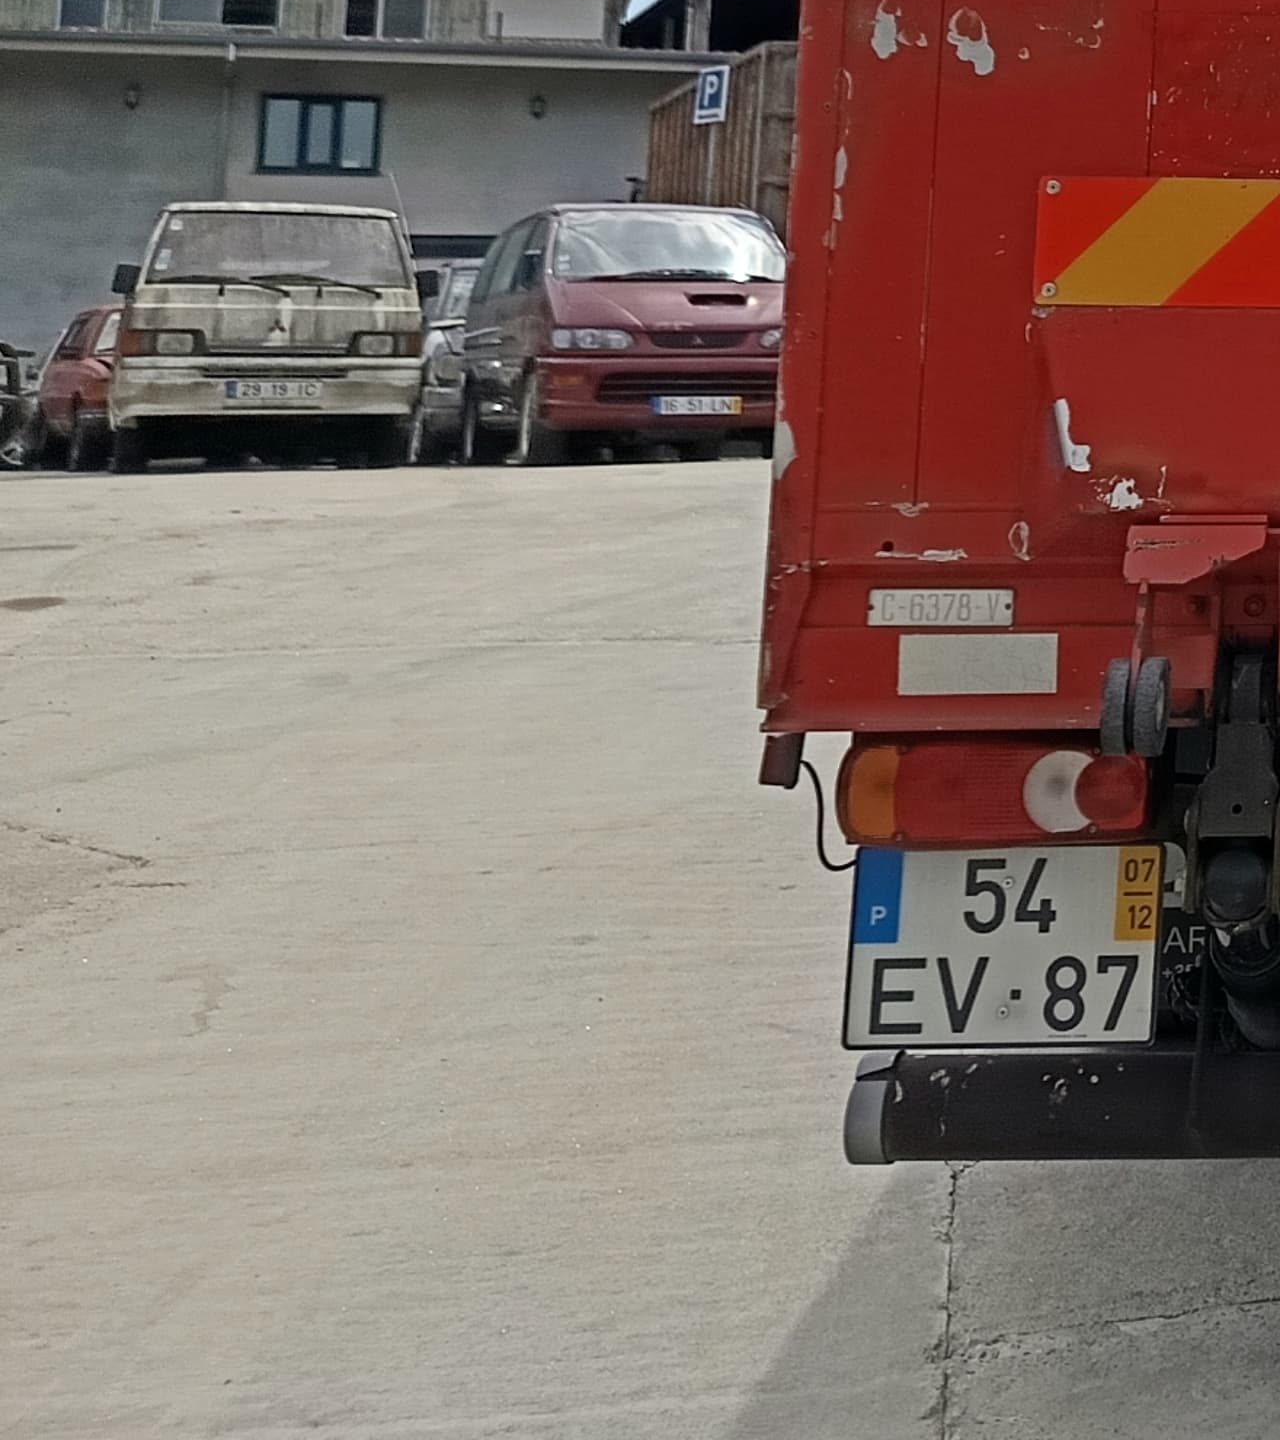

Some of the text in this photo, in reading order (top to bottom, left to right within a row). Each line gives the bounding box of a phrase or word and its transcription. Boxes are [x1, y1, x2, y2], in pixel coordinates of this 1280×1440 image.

[703, 74, 720, 108] P
[881, 593, 999, 622] C-6378-V
[1123, 859, 1155, 883] 07
[963, 858, 1057, 933] 54
[869, 905, 887, 926] P
[1127, 904, 1153, 931] 12
